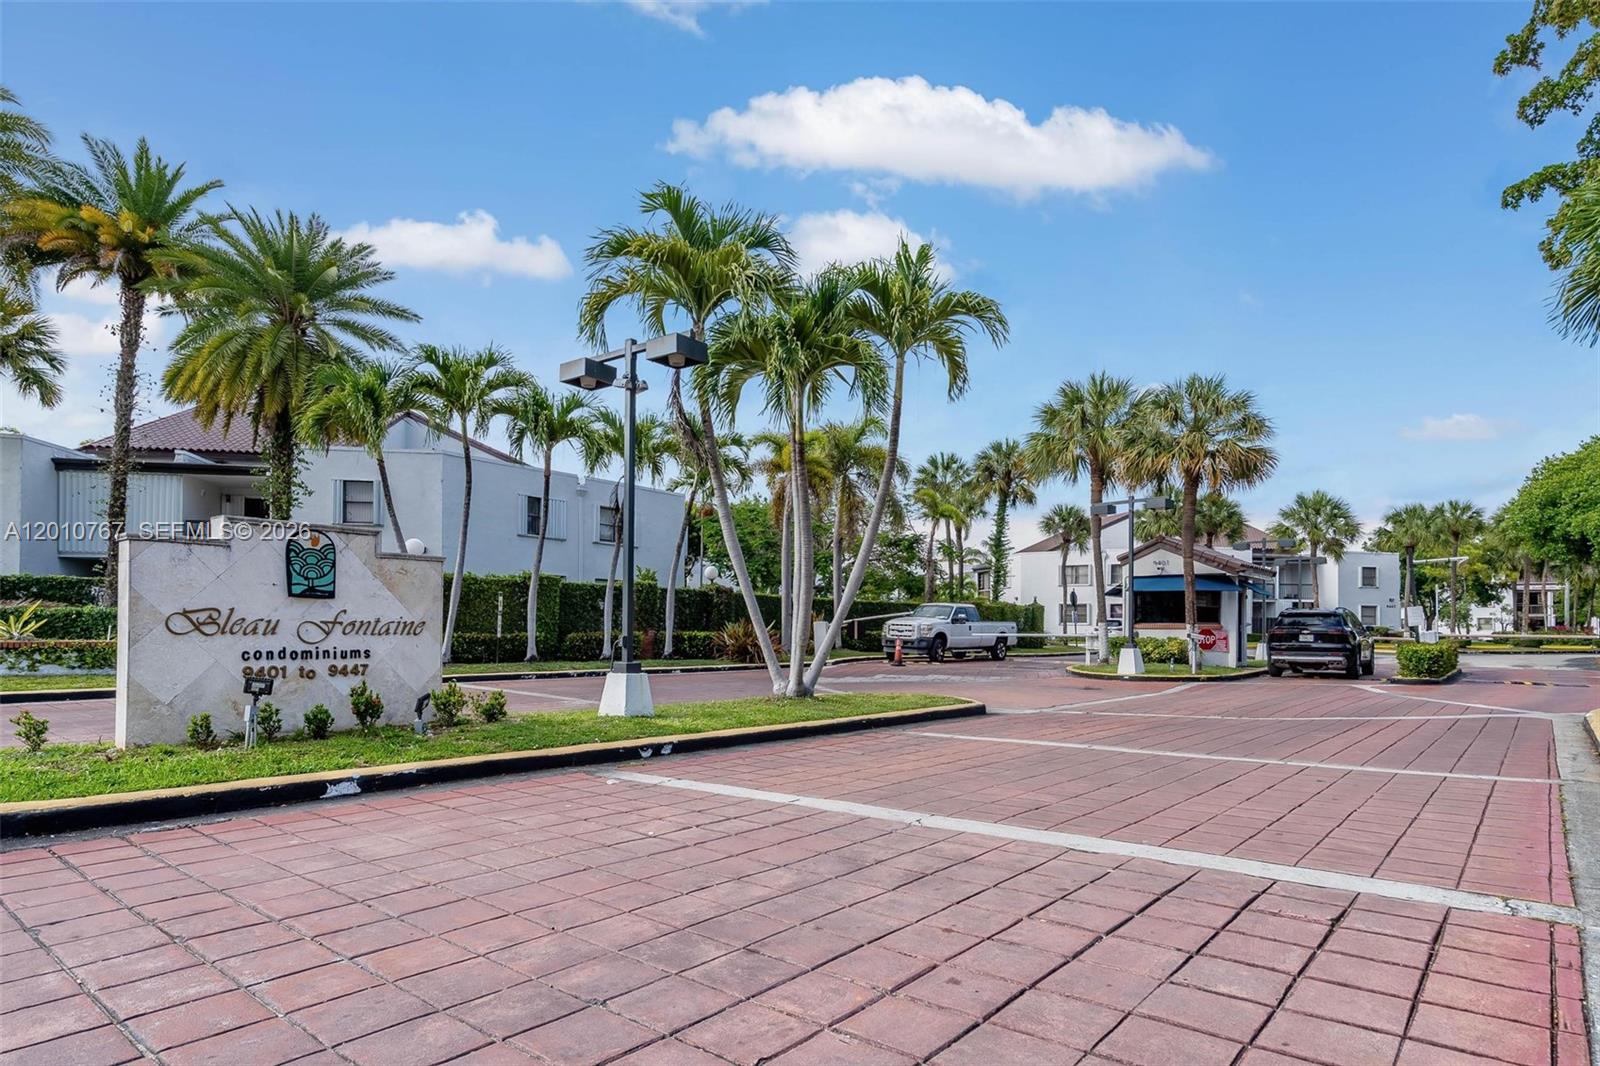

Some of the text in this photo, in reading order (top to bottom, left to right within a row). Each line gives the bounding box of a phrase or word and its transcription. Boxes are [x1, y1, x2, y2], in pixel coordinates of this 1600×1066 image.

[164, 607, 427, 645] Bleau Fontaine
[241, 646, 372, 661] condominiums
[241, 663, 370, 680] 9401 to 9447
